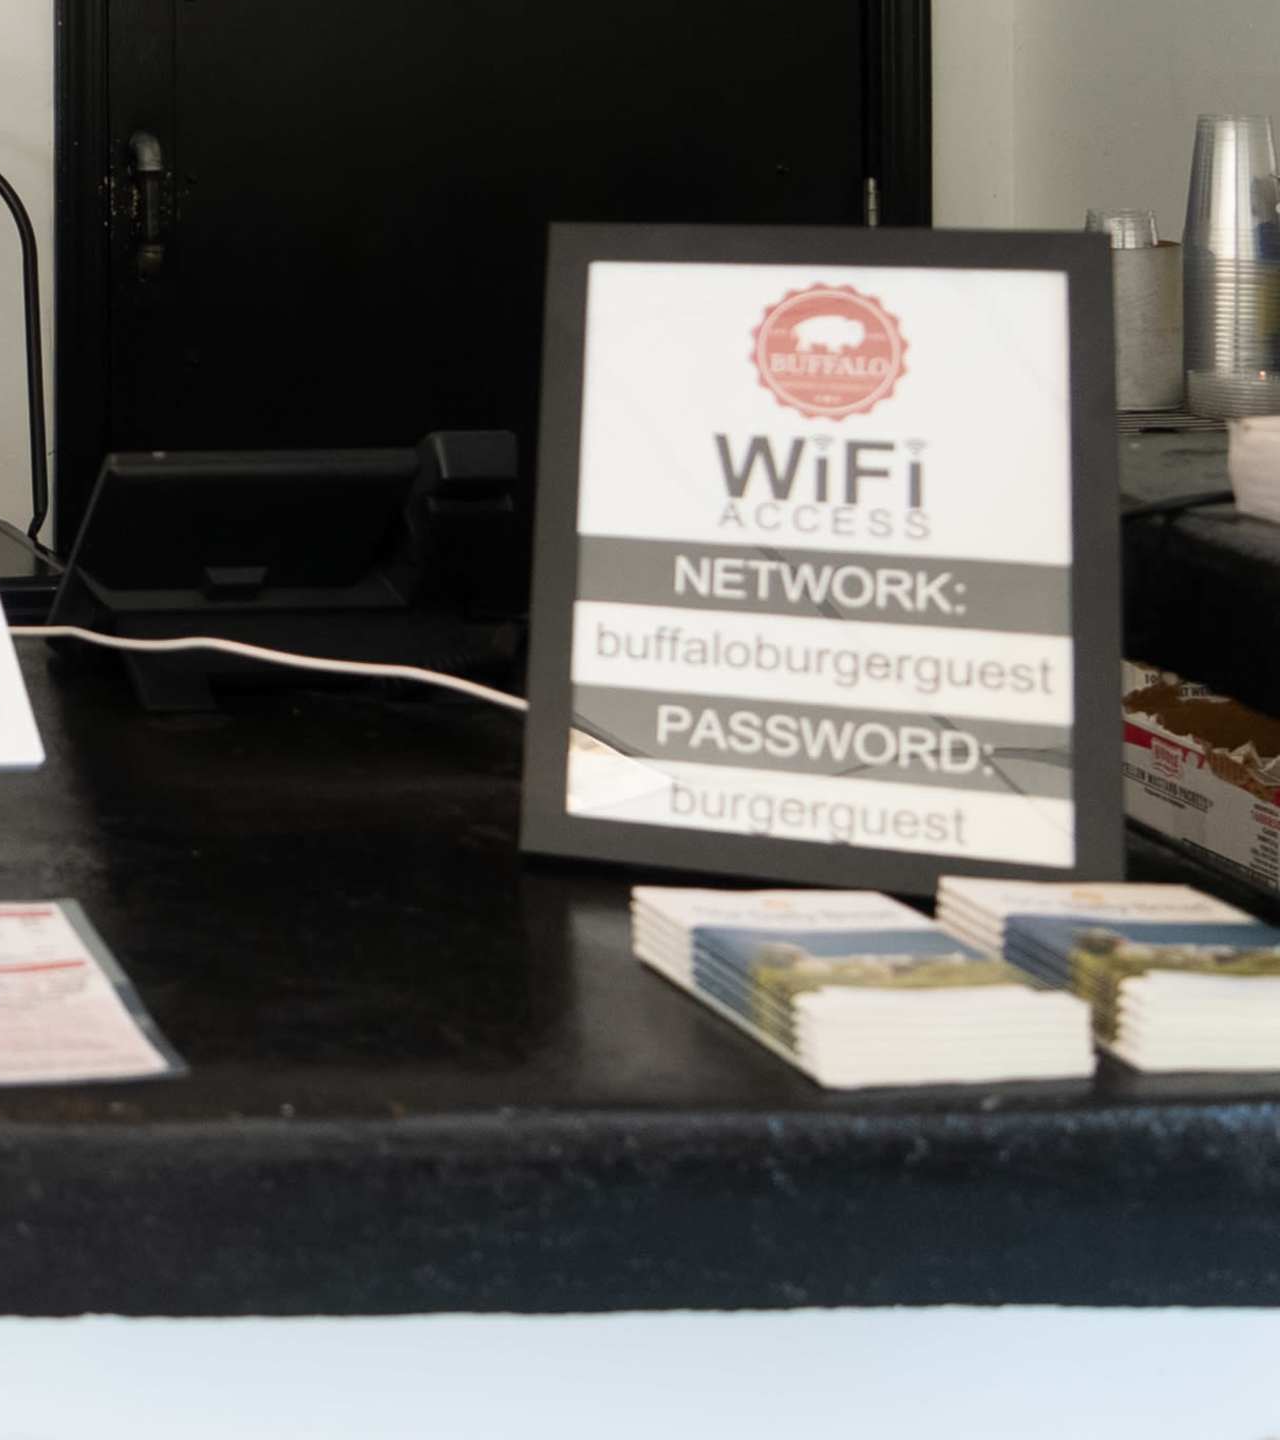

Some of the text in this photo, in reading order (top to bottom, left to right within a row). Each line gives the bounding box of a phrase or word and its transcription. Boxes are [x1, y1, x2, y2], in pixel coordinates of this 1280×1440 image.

[713, 433, 927, 510] WiFi
[719, 501, 933, 540] ACCESS
[674, 554, 967, 616] NETWORK:
[595, 622, 1054, 696] buffaloburgerguest
[656, 704, 996, 776] PASSWORD:
[668, 781, 966, 847] burgerguest
